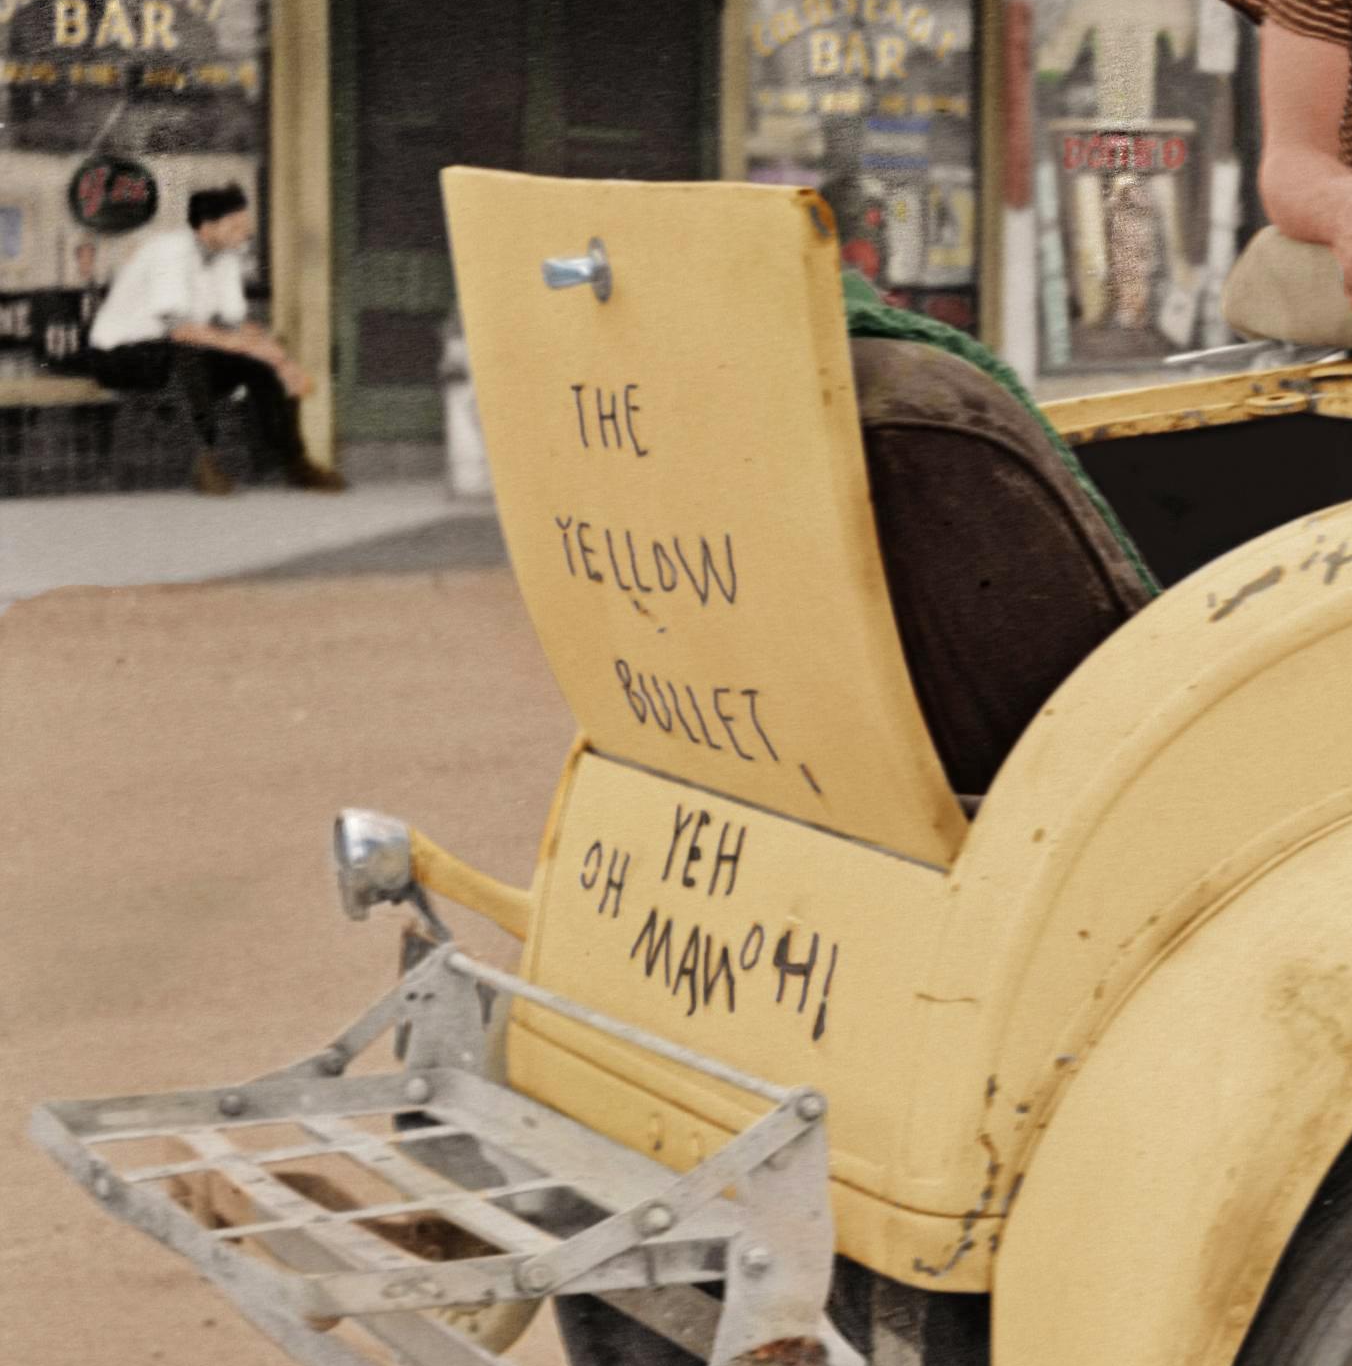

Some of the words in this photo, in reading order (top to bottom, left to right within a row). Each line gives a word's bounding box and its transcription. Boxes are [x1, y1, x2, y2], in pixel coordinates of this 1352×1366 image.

[810, 30, 909, 81] BAR
[571, 383, 649, 458] THE
[556, 515, 737, 606] YELLOW
[580, 839, 631, 918] OH
[661, 802, 747, 896] YEH
